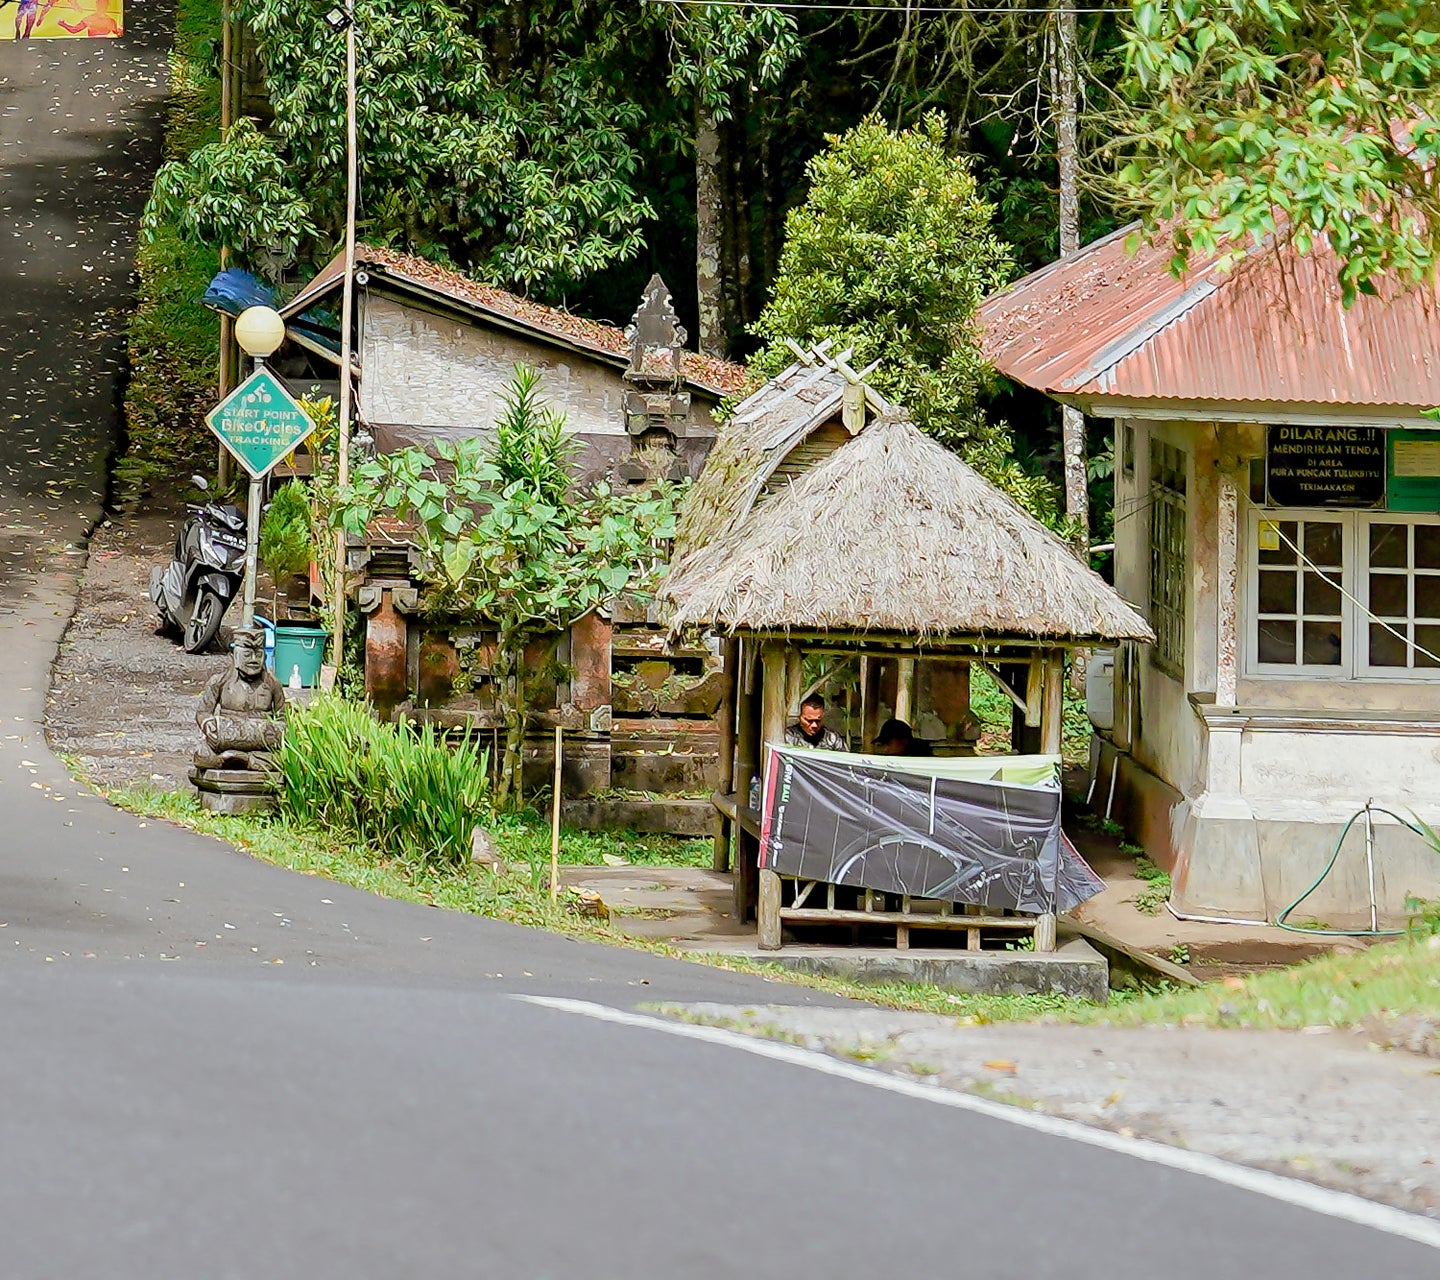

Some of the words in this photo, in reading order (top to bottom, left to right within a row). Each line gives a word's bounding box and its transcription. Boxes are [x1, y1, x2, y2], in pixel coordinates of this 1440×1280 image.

[223, 407, 260, 418] START
[263, 410, 298, 420] POINT
[229, 435, 291, 446] TRACKING
[1273, 444, 1342, 455] MENDIRIKAN
[1345, 445, 1380, 456] TENDA
[1307, 459, 1316, 467] DI
[1271, 468, 1295, 477] PURA
